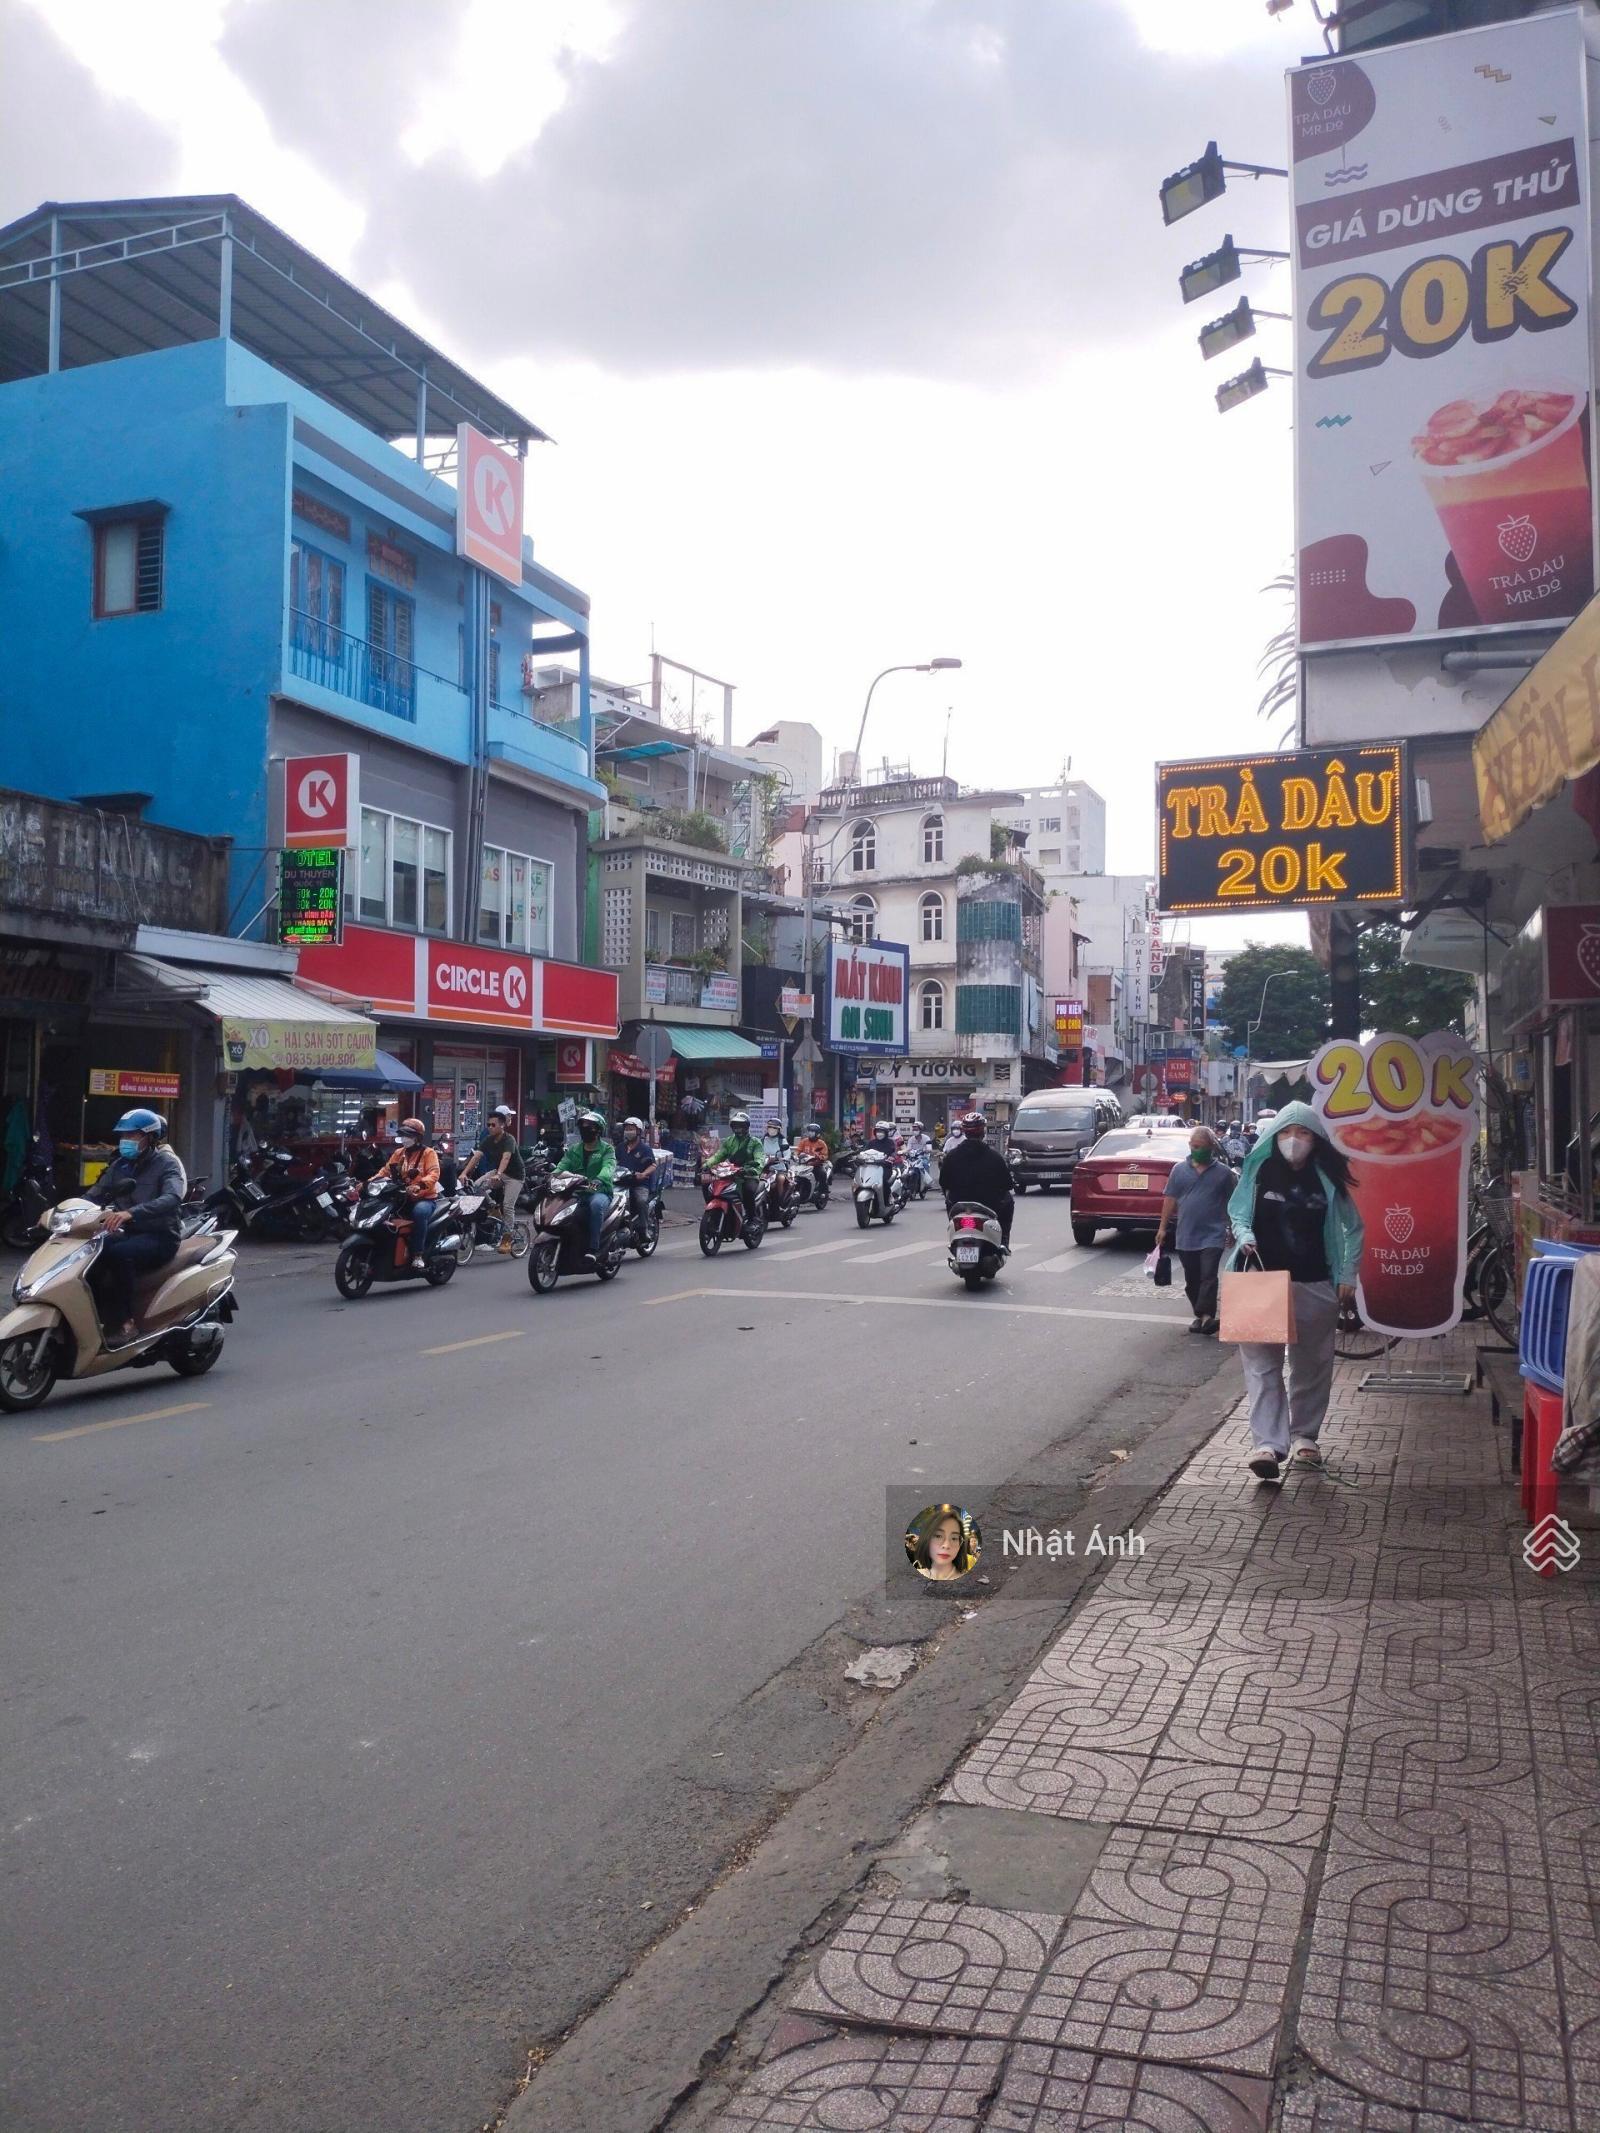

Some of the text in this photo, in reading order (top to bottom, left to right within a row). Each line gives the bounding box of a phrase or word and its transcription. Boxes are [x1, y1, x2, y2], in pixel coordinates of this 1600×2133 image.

[1305, 158, 1573, 249] GIÁ DÙNG THỬ
[1309, 228, 1577, 377] 20K
[1488, 554, 1565, 590] TRÀ DÂU
[1166, 758, 1395, 839] TRÀ DÂU
[436, 963, 499, 997] CIRCLE
[834, 947, 903, 1005] MẮT KÍNH
[247, 1023, 269, 1049] XÔ
[346, 1032, 373, 1049] CAJUN
[841, 1005, 894, 1041] AN SINH
[1317, 1039, 1474, 1120] 20K
[1371, 1245, 1430, 1260] TRÀ DÂU
